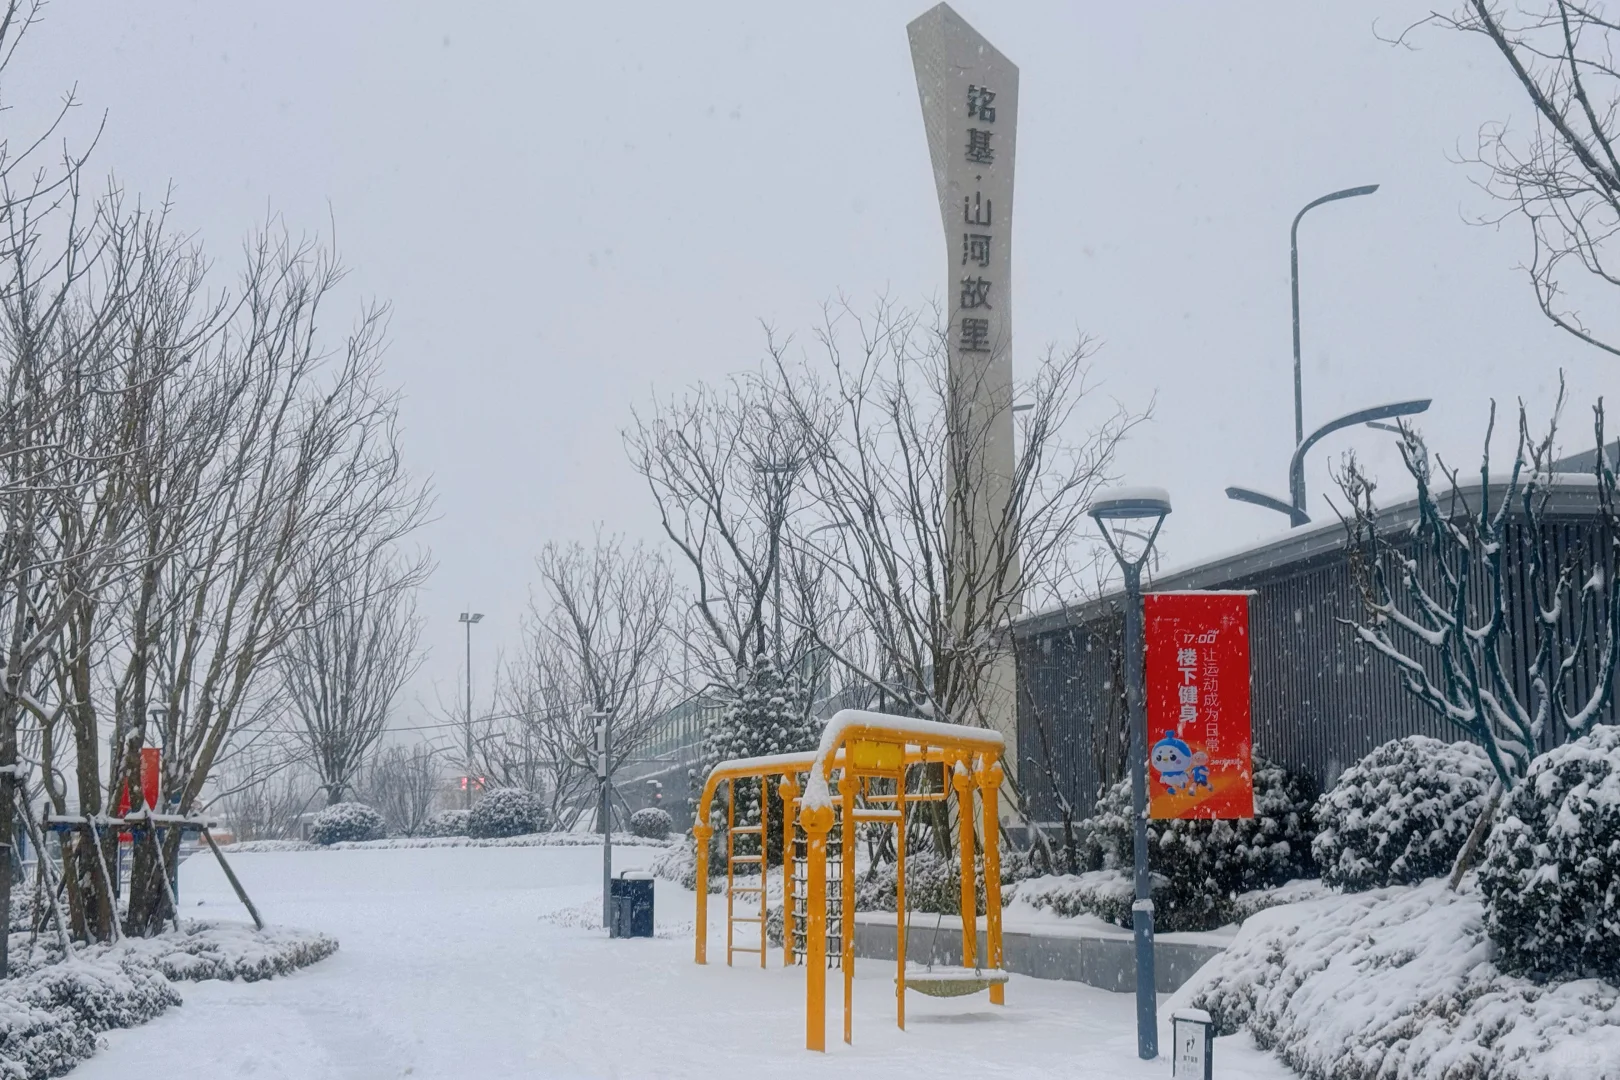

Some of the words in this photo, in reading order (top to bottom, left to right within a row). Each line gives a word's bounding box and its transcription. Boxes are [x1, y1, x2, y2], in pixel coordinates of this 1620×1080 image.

[959, 84, 997, 353] 铭基·山河故里
[1183, 634, 1217, 644] 17:00
[1177, 648, 1198, 723] 楼下健身
[1202, 648, 1220, 752] 让运动成为日常
